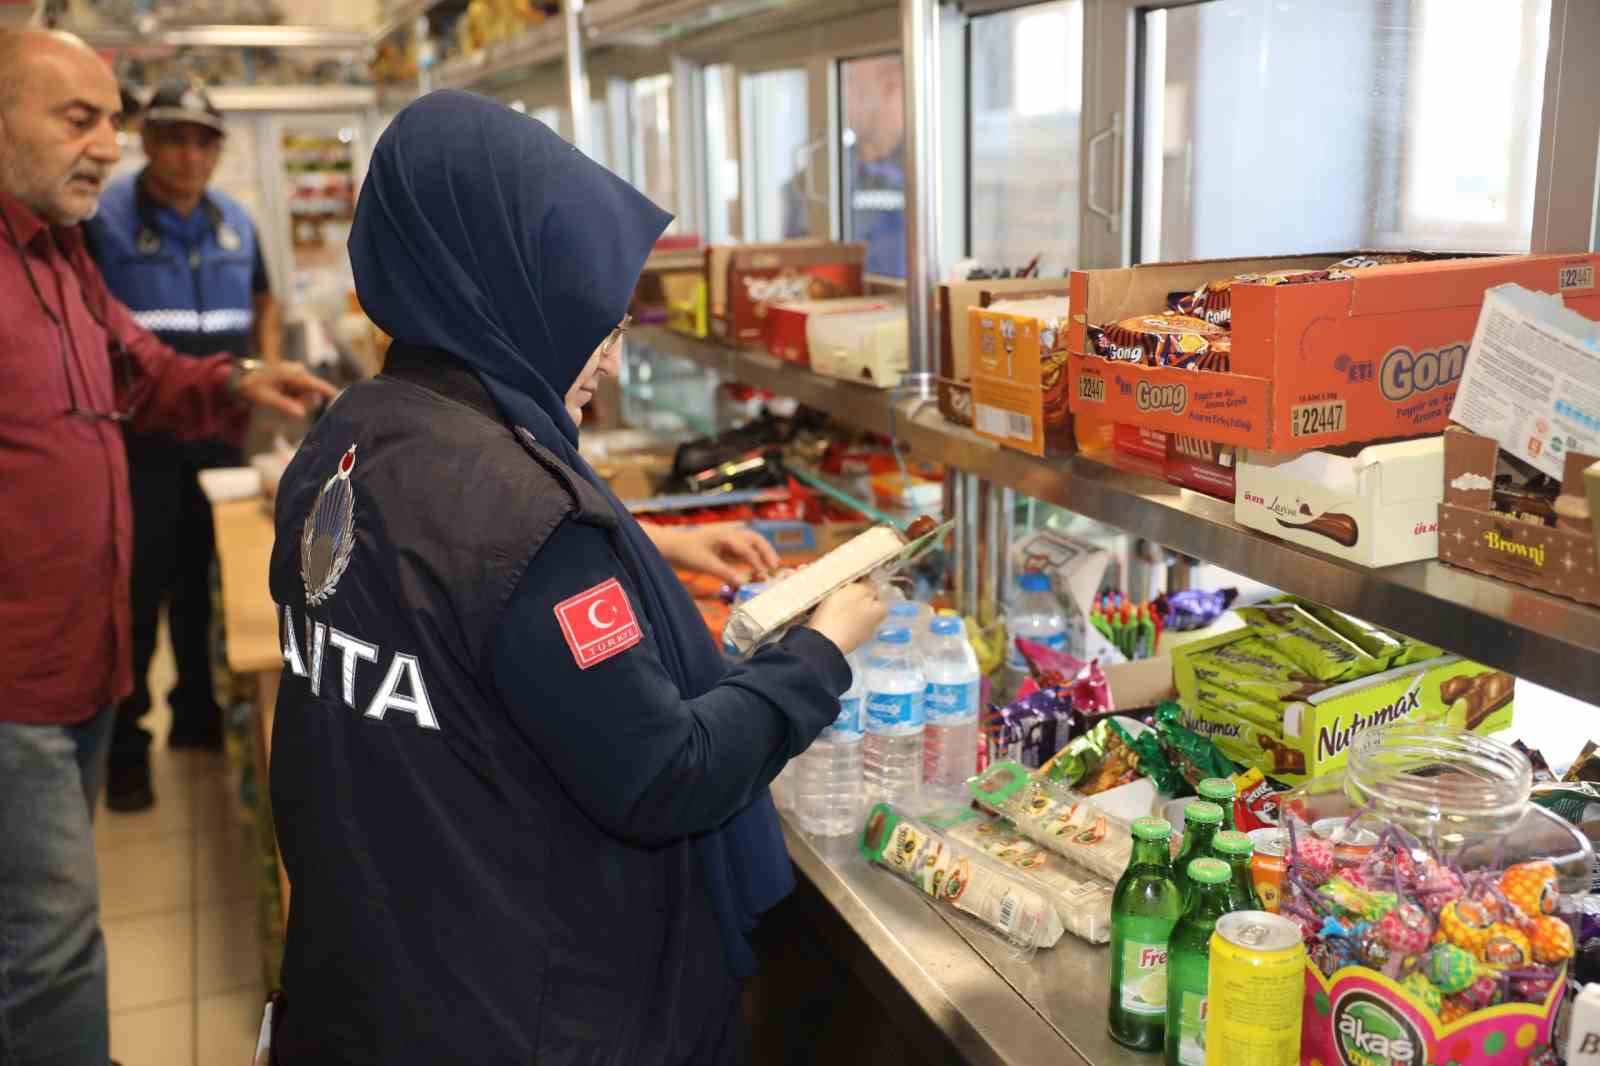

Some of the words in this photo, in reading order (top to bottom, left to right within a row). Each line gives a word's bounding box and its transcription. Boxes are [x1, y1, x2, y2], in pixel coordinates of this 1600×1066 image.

[1206, 309, 1231, 324] Gon
[1379, 344, 1470, 401] Gon
[1135, 379, 1187, 415] Gong
[1302, 404, 1343, 435] 22447
[1483, 529, 1545, 567] Browni
[1179, 709, 1241, 739] Nutymax
[1317, 686, 1421, 762] Nutymax
[1140, 947, 1168, 968] Fre
[1339, 1012, 1415, 1061] akas
